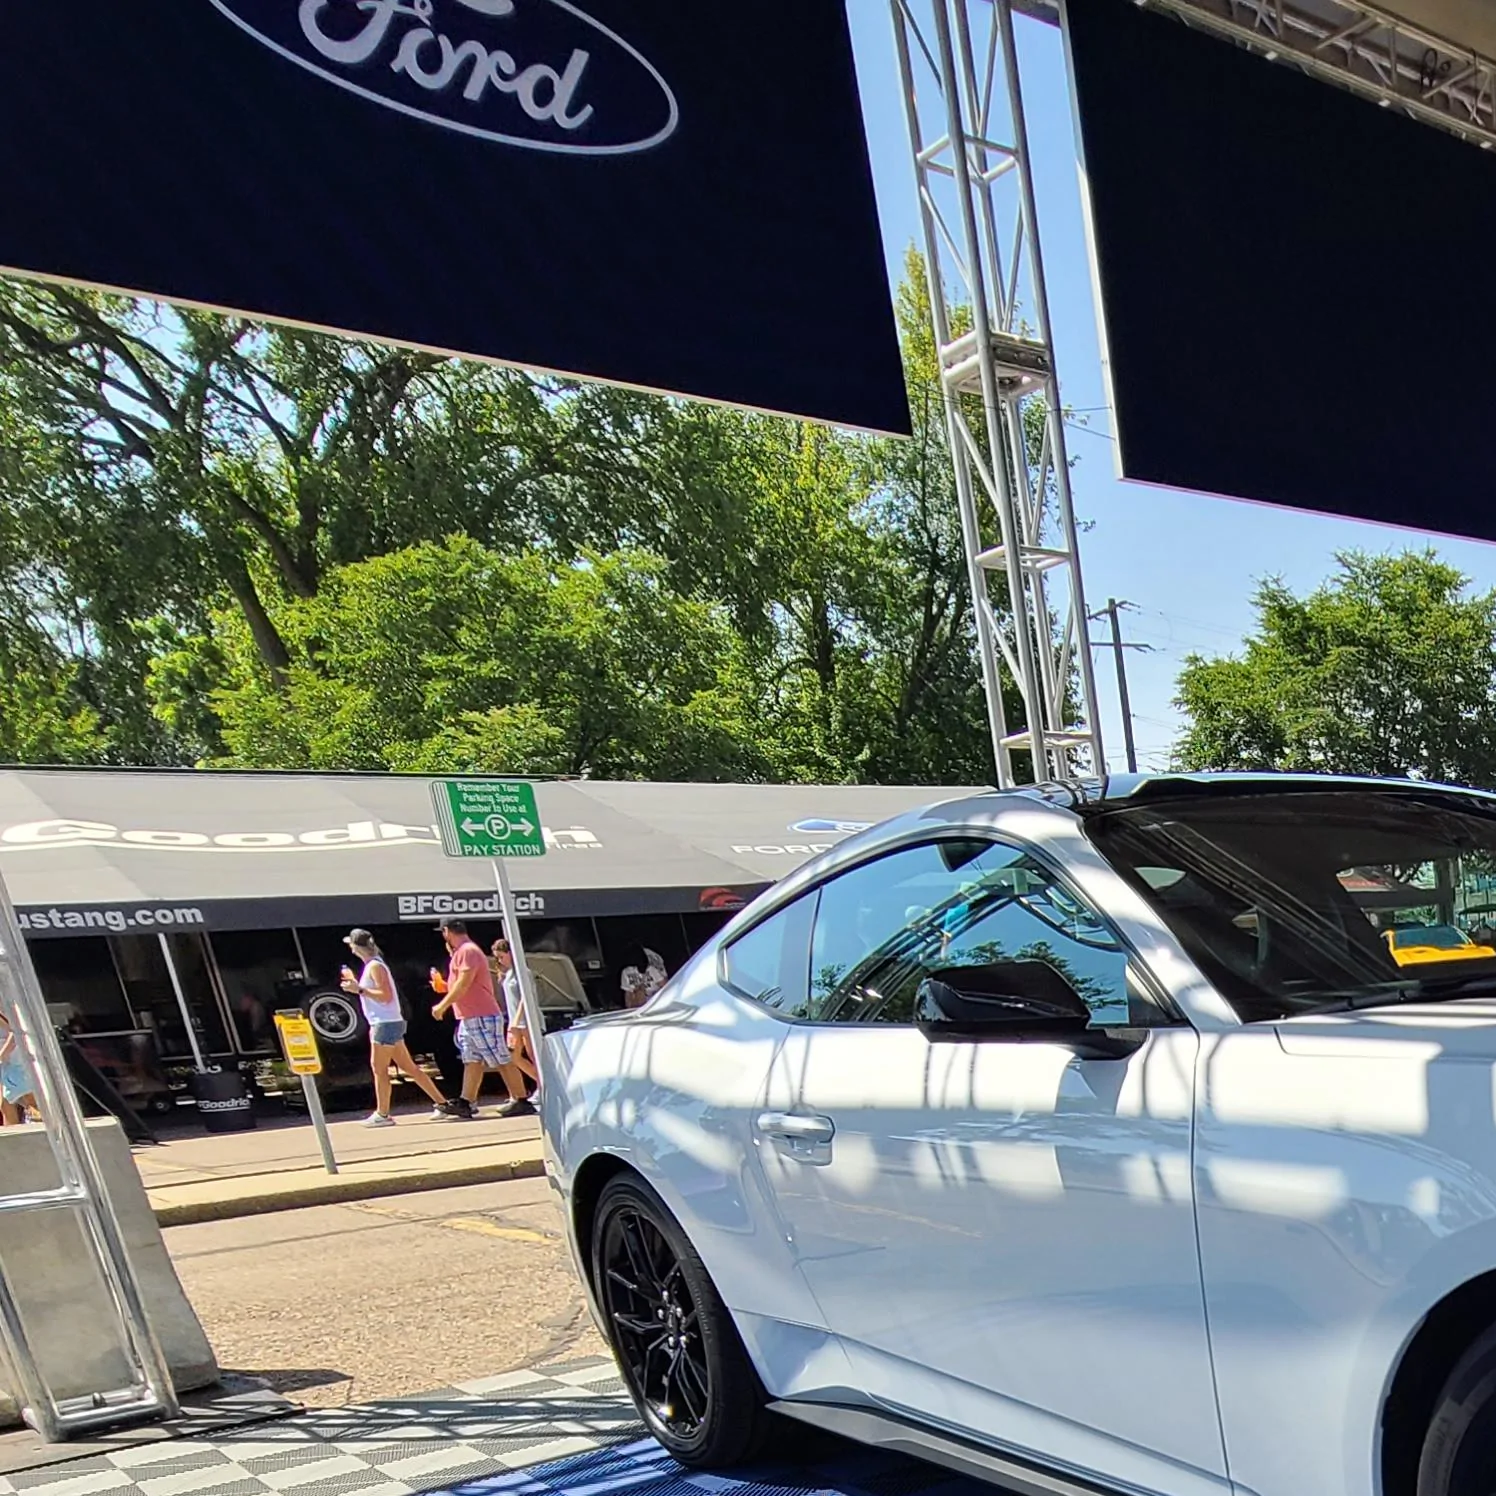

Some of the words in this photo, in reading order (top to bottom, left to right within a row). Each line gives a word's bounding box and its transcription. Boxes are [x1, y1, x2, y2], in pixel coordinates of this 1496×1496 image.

[299, 0, 594, 129] Ford
[463, 793, 494, 804] Parking
[495, 793, 519, 803] Space
[459, 803, 491, 812] Number
[464, 845, 488, 855] PAY
[493, 845, 540, 855] STATION
[398, 892, 545, 913] BFGoodich
